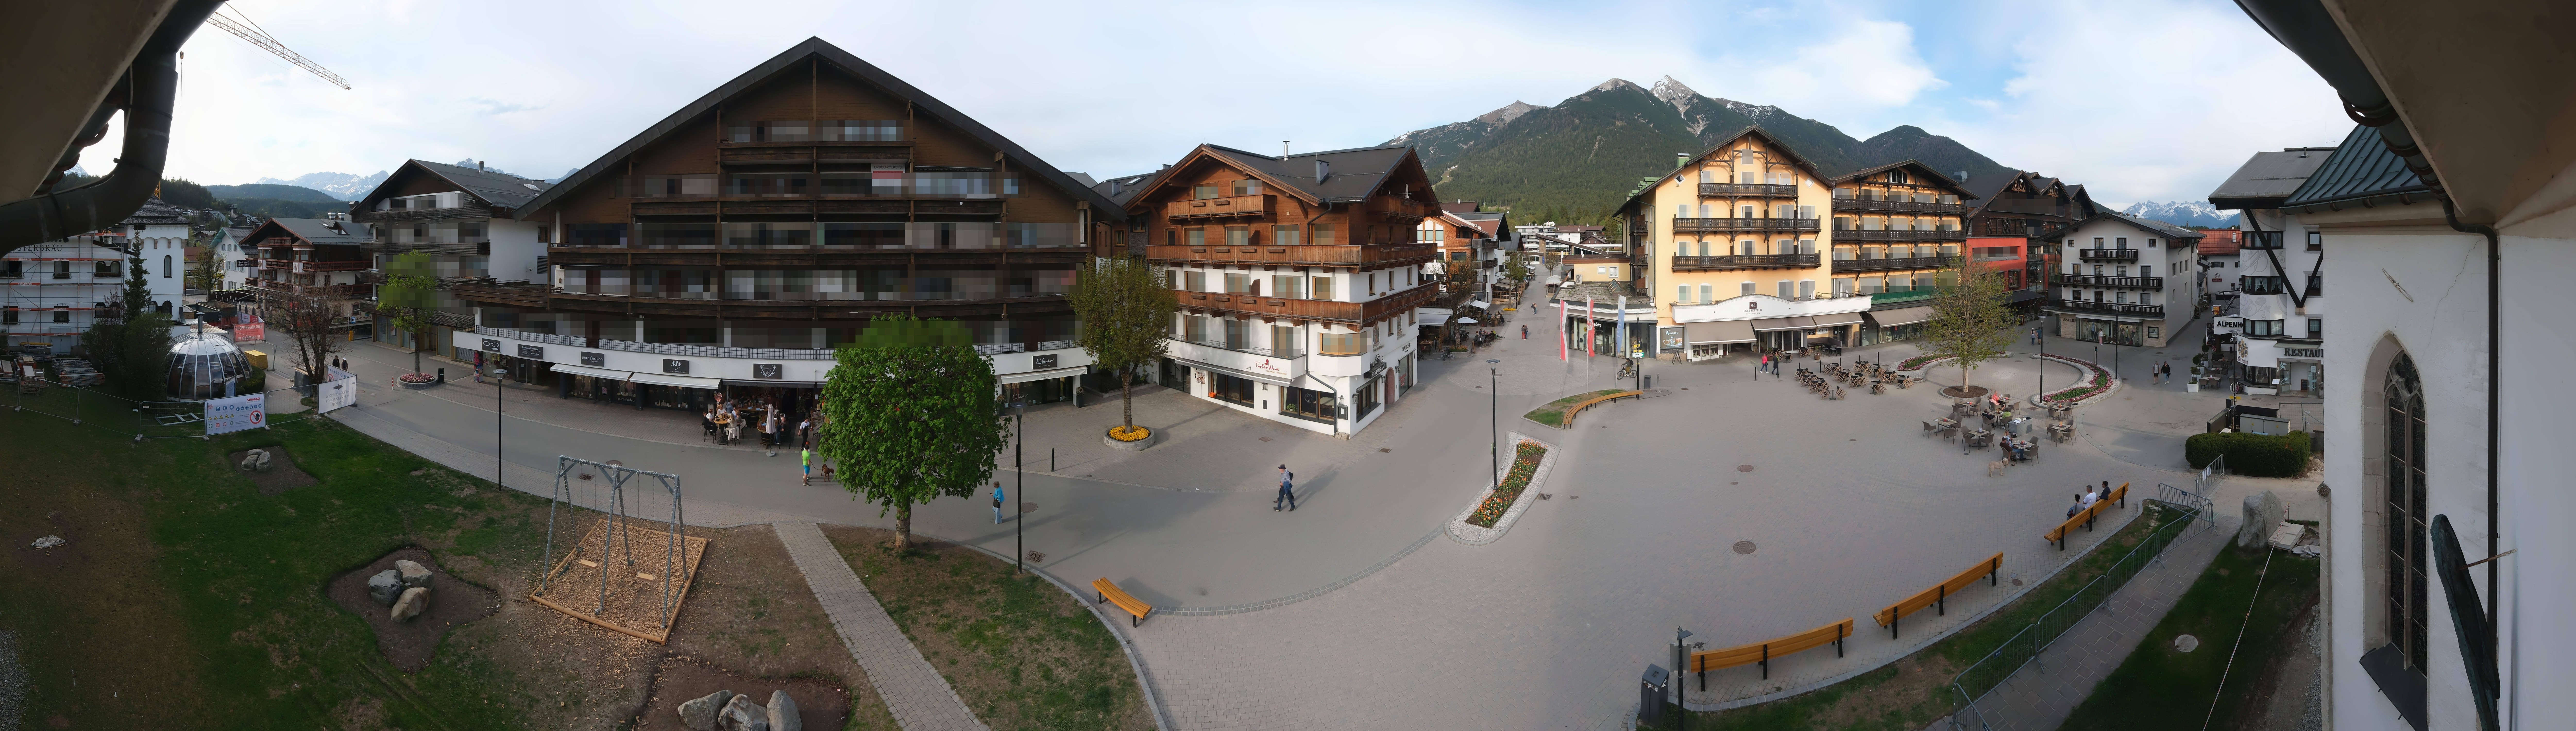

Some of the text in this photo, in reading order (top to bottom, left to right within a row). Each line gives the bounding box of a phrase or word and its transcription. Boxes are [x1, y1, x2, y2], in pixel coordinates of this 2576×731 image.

[1402, 343, 1411, 351] SAILER
[1372, 364, 1386, 377] RESTAURANT
[326, 394, 349, 403] KONGRESSZENTRUM
